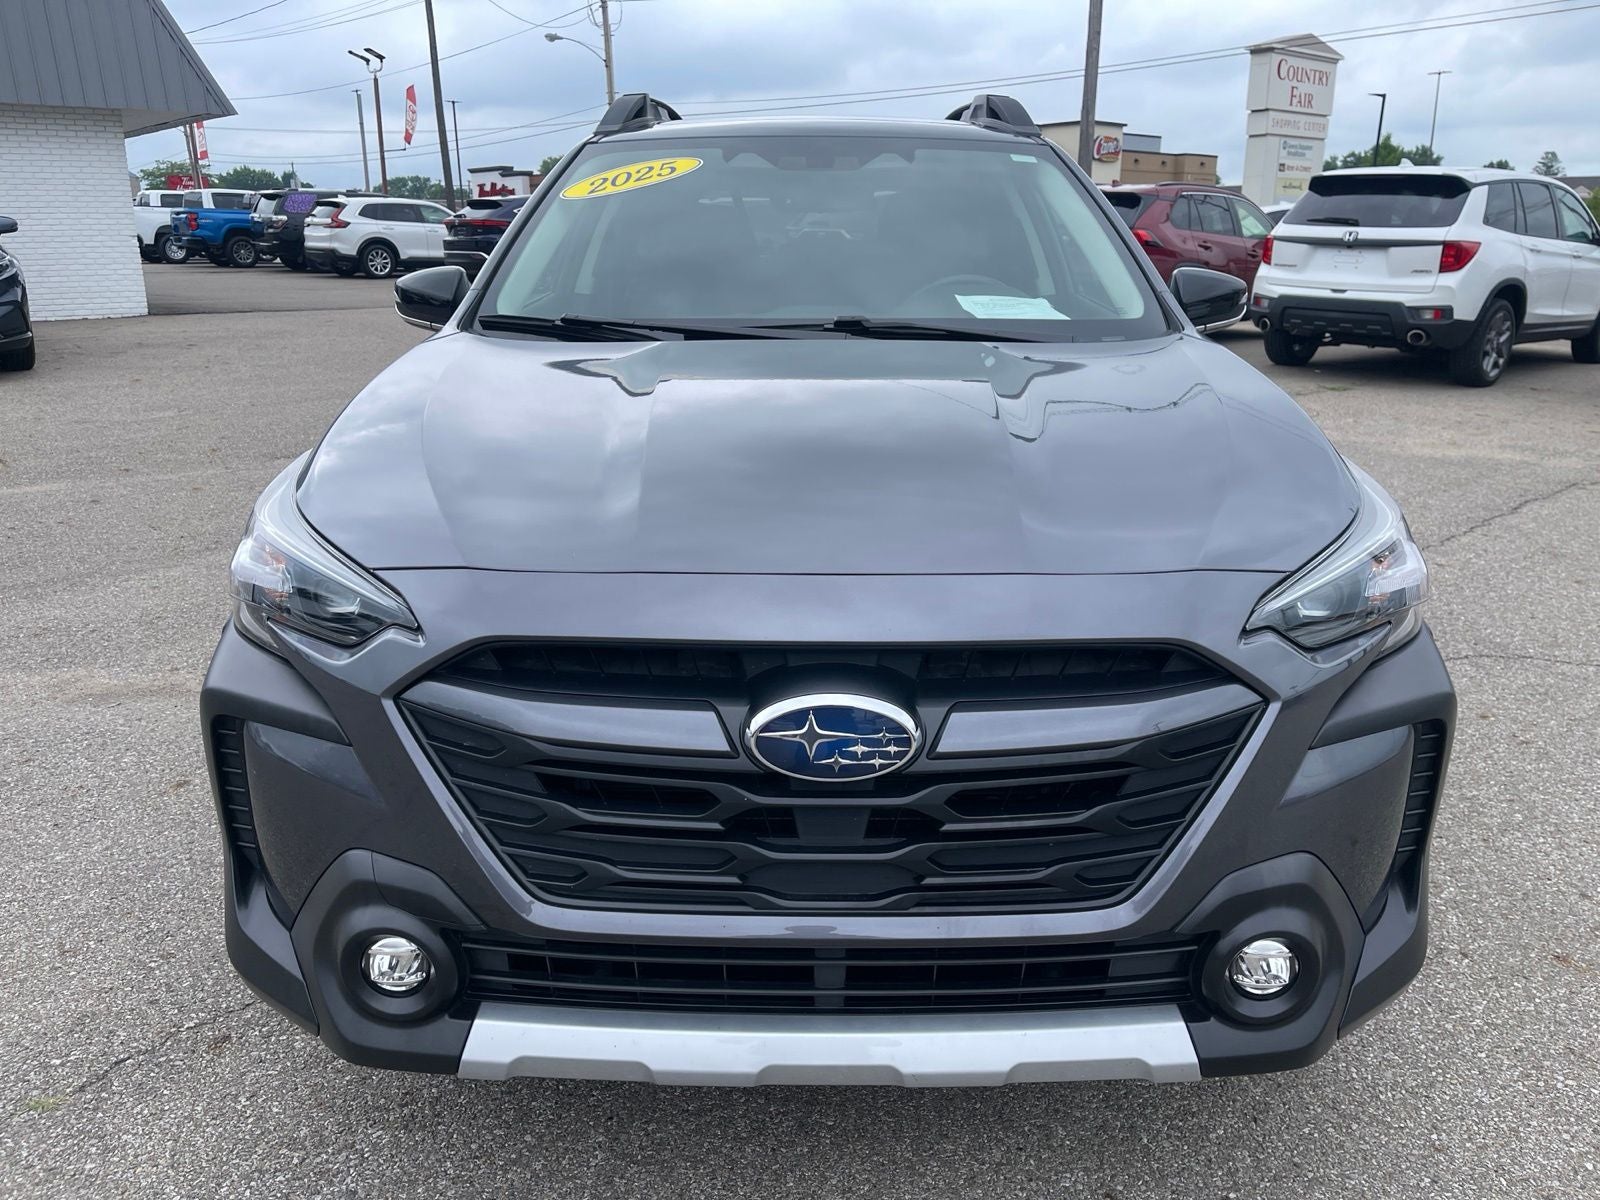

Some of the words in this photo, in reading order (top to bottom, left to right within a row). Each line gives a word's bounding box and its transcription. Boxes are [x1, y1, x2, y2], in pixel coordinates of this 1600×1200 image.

[1277, 58, 1332, 87] COUNTRY
[1289, 86, 1314, 109] FAIR
[587, 160, 678, 196] 2025
